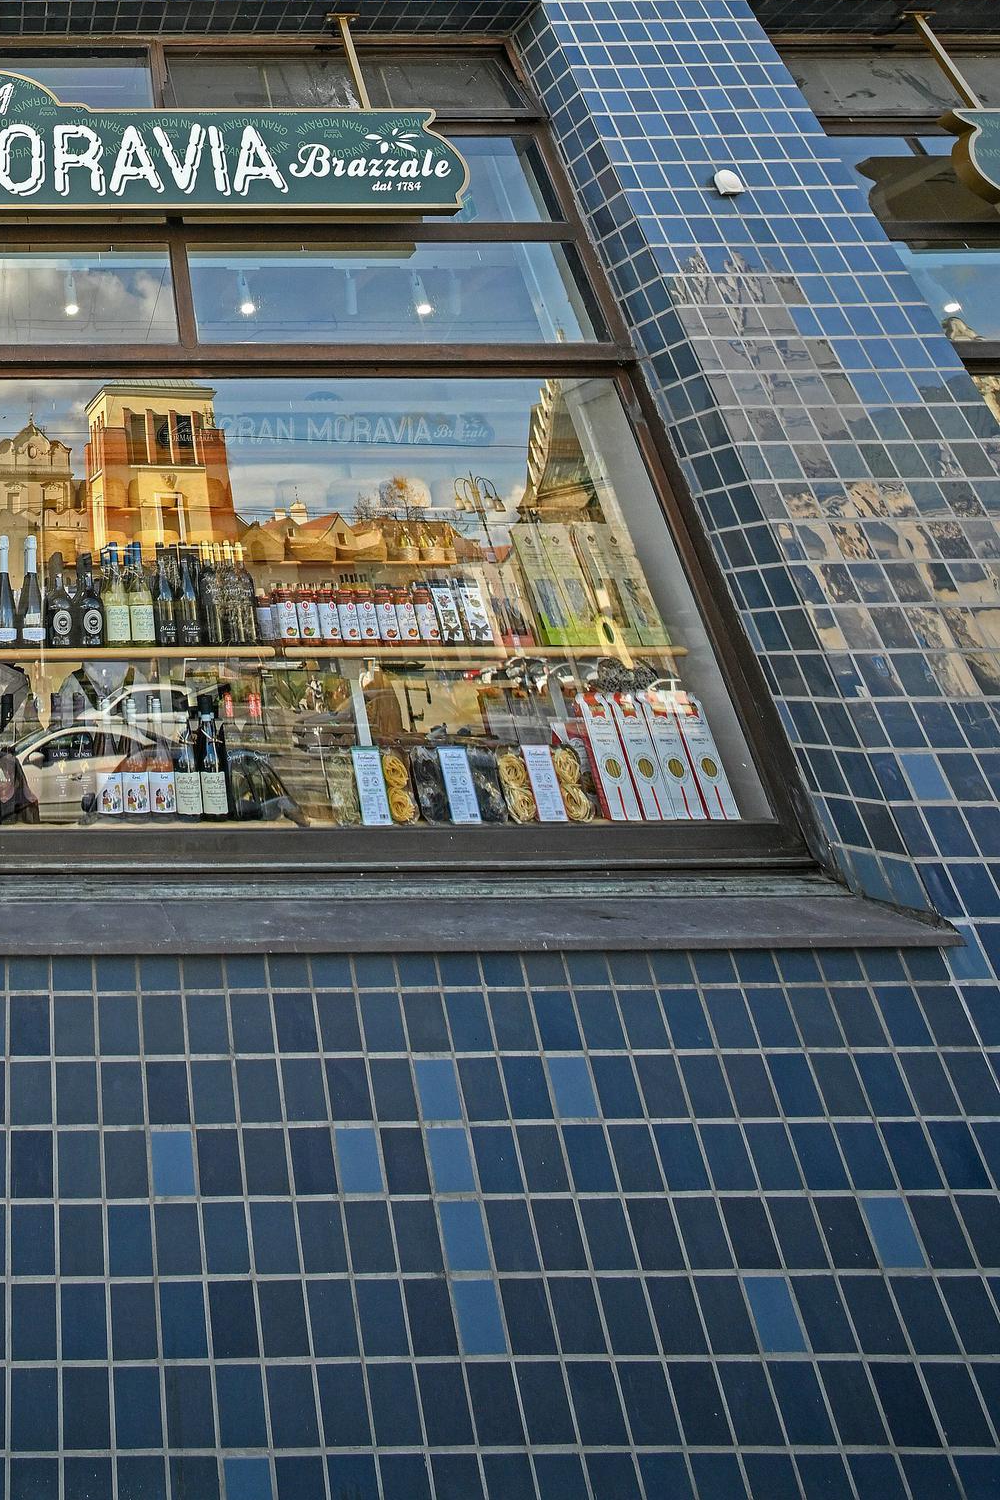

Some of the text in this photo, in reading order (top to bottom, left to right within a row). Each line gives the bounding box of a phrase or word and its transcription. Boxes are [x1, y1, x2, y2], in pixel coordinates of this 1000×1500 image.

[289, 143, 451, 178] Brazzale
[372, 181, 422, 191] dal 1784
